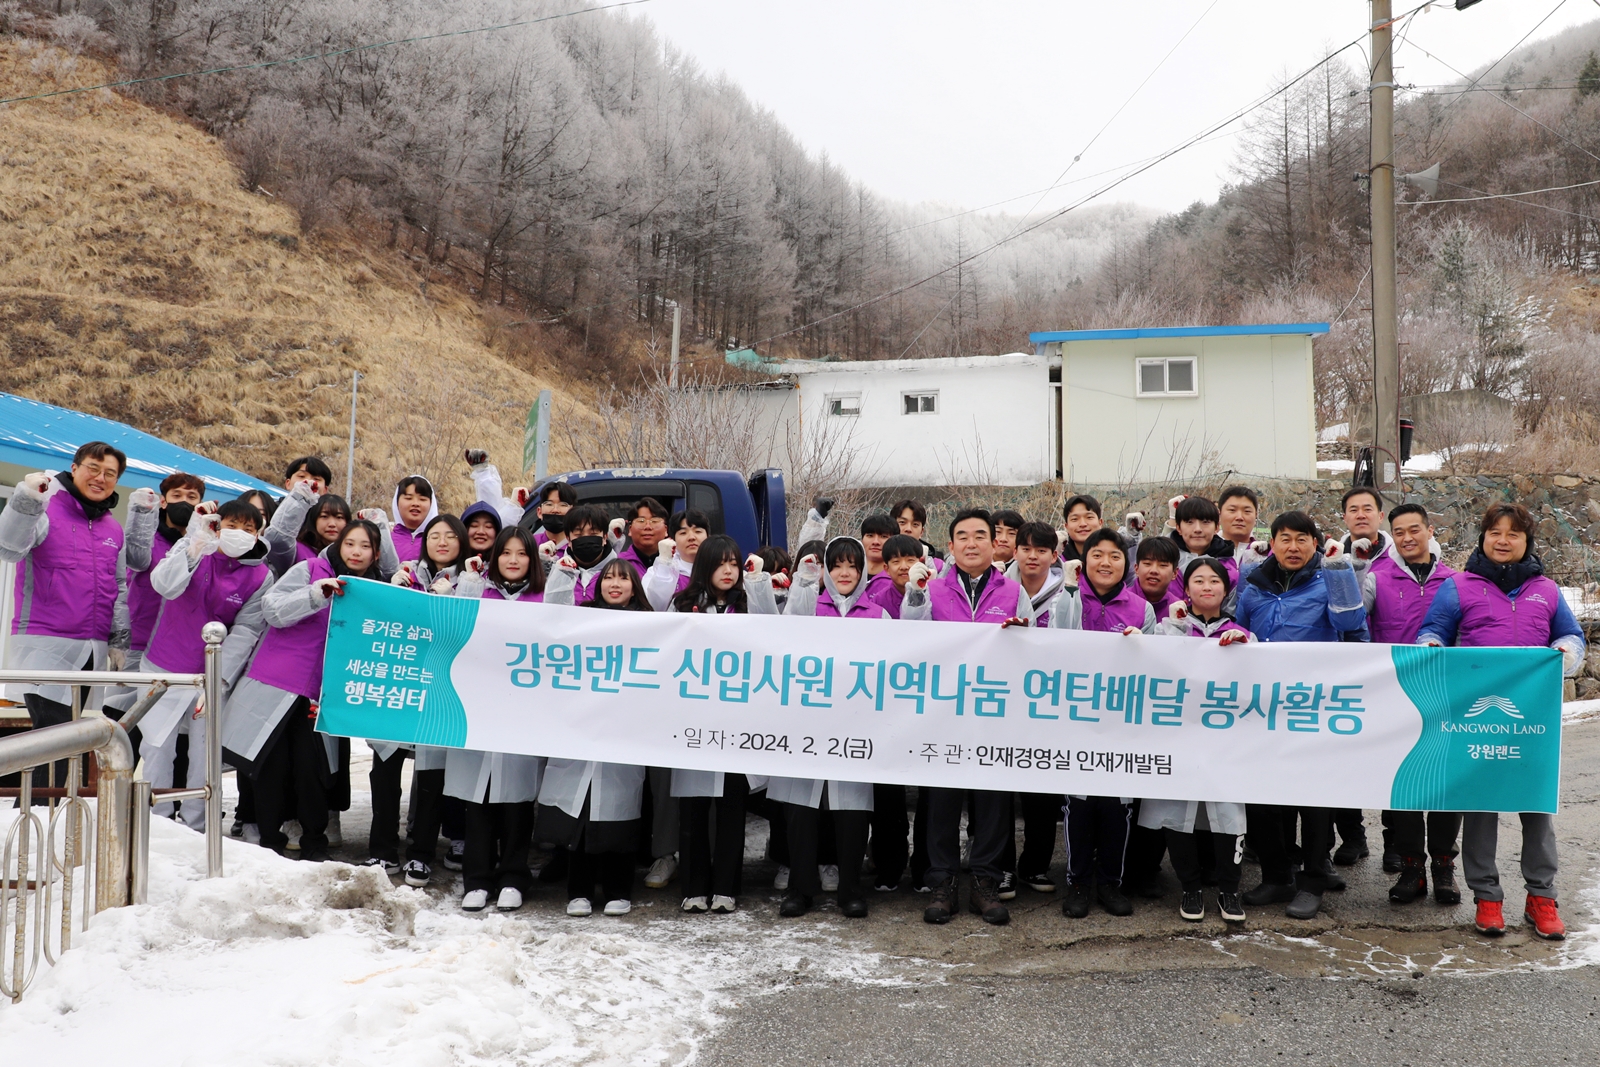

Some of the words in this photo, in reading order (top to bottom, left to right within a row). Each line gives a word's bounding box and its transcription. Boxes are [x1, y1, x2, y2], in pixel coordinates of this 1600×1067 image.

[361, 618, 404, 639] 즐거운
[406, 624, 434, 642] 삶과
[371, 641, 386, 657] 더
[389, 643, 417, 661] 나은
[345, 659, 389, 680] 세상을
[392, 664, 434, 684] 만드는
[344, 680, 427, 712] 행복쉼터
[506, 643, 660, 693] 강원랜드
[673, 649, 833, 708] 신입사원
[846, 660, 1010, 717] 지역나눔
[1024, 670, 1190, 726] 연탄배달
[1200, 681, 1365, 735] 봉사활동
[1441, 721, 1510, 734] KANGWON
[1513, 723, 1546, 735] LAND
[976, 746, 1070, 770] 인재경영실
[1077, 751, 1171, 775] 인재개발팀
[1467, 744, 1521, 760] 강원랜드
